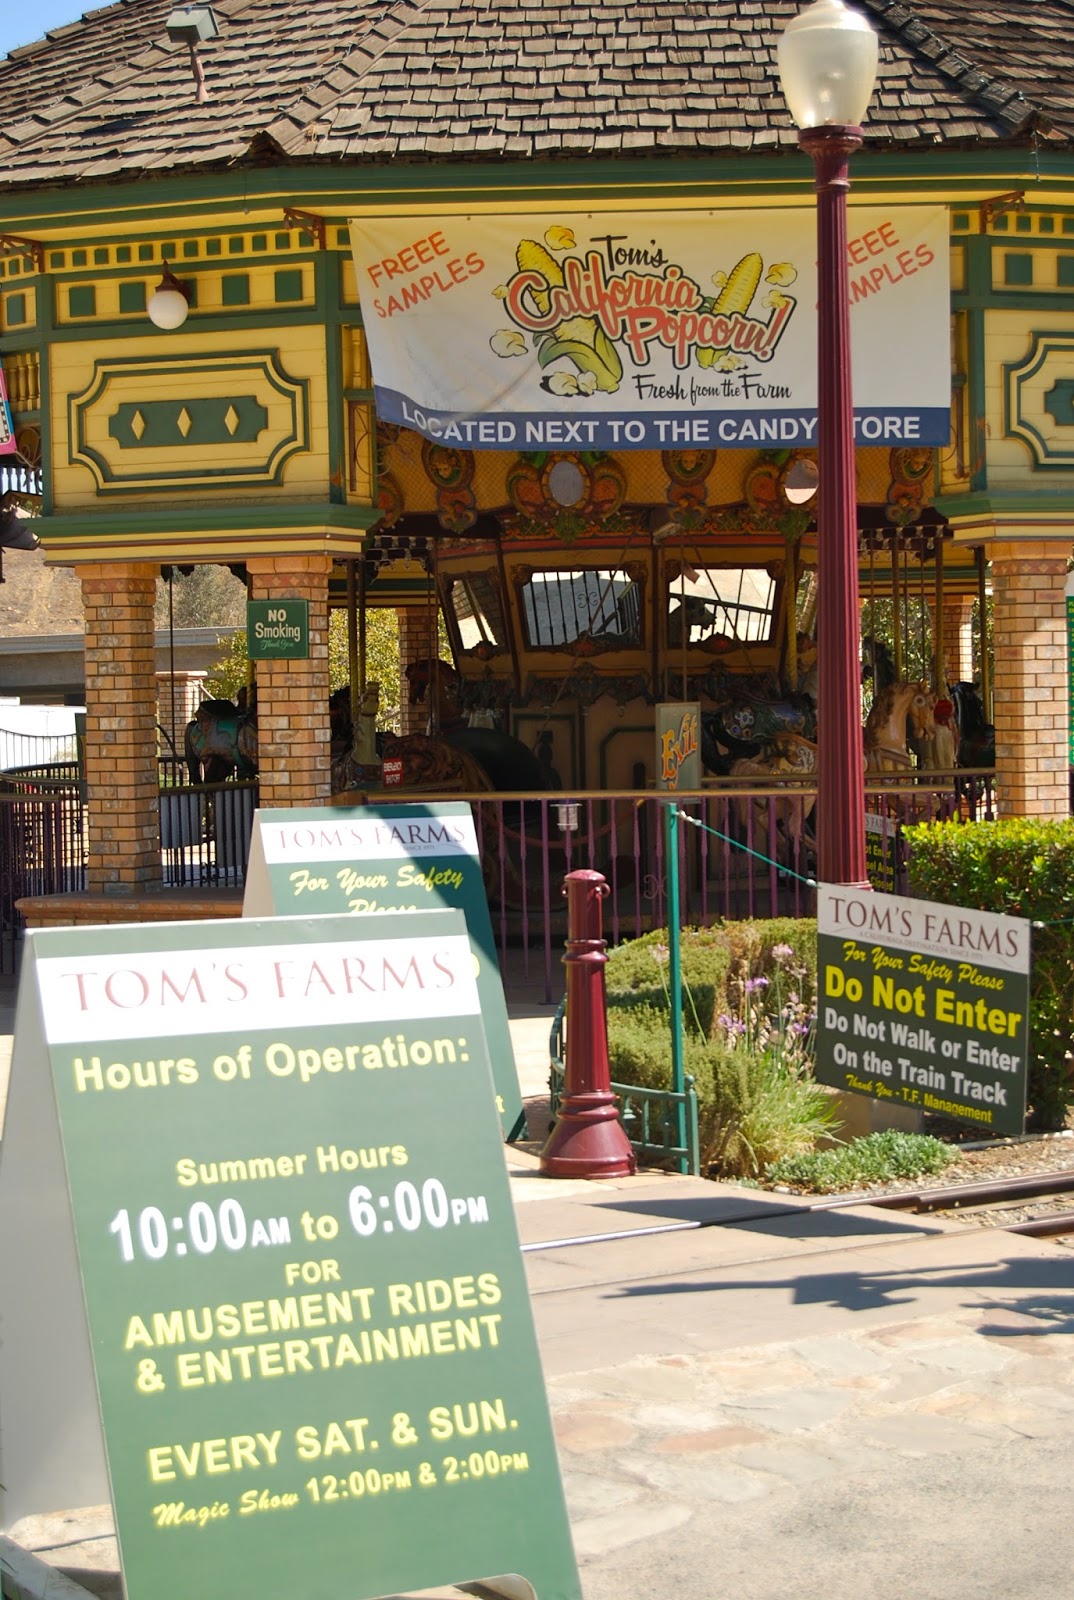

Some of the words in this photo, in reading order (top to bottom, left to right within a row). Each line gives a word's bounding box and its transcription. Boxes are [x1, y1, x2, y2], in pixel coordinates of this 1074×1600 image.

[367, 231, 450, 288] FREEE
[590, 235, 668, 271] Tom's
[816, 243, 935, 311] MPLES
[373, 252, 485, 318] SAMPLES
[505, 251, 702, 339] California
[623, 296, 796, 368] Popcorn!
[632, 374, 688, 400] Fresh
[690, 377, 721, 405] from
[721, 380, 741, 397] the
[738, 373, 792, 400] Farm
[401, 401, 517, 443] LOCATED
[525, 421, 600, 442] NEXT
[607, 420, 646, 442] TO
[653, 419, 710, 442] THE
[718, 417, 818, 441] CANDY
[853, 416, 920, 439] TORE
[255, 622, 301, 642] Smoking
[268, 609, 287, 622] NO
[661, 712, 698, 790] Exit
[273, 825, 363, 849] TOM'S
[375, 823, 466, 847] FARMS
[873, 845, 891, 859] Ener
[289, 870, 329, 896] For
[336, 867, 389, 896] Your
[396, 865, 464, 891] Safety
[828, 896, 912, 937] TOM'S
[924, 914, 1018, 957] FARMS
[60, 962, 250, 1011] TOM'S
[274, 951, 456, 998] FARMS
[843, 941, 867, 962] For
[871, 947, 904, 970] Your
[908, 954, 953, 983] Safety
[957, 964, 1005, 990] Please
[825, 965, 863, 1002] Do
[872, 975, 926, 1018] Not
[935, 988, 1022, 1037] Enter
[74, 1057, 198, 1092] Hours
[213, 1045, 254, 1081] of
[265, 1034, 470, 1083] Operation:
[825, 1007, 848, 1033] Do
[853, 1013, 886, 1042] Not
[890, 1022, 936, 1054] Walk
[941, 1040, 962, 1059] or
[966, 1040, 1021, 1073] Enter
[833, 1042, 858, 1069] On
[863, 1051, 893, 1076] the
[897, 1057, 946, 1091] Train
[951, 1071, 1008, 1106] Track
[845, 1074, 873, 1092] Thank
[875, 1082, 893, 1098] You
[901, 1087, 922, 1105] T.F.
[924, 1093, 992, 1123] Management
[176, 1153, 307, 1188] Summer
[317, 1144, 409, 1173] Hours
[301, 1210, 339, 1241] to
[285, 1259, 341, 1287] FOR
[125, 1287, 375, 1350] AMUSEMENT
[389, 1273, 502, 1316] RIDES
[136, 1357, 166, 1394] &
[177, 1314, 502, 1388] ENTERTAINMENT
[148, 1430, 282, 1482] EVERY
[296, 1418, 379, 1460] SAT.
[391, 1411, 418, 1446] &
[428, 1398, 519, 1439] SUN.
[153, 1500, 230, 1526] Magic
[238, 1489, 300, 1515] Show
[418, 1461, 436, 1486] &
